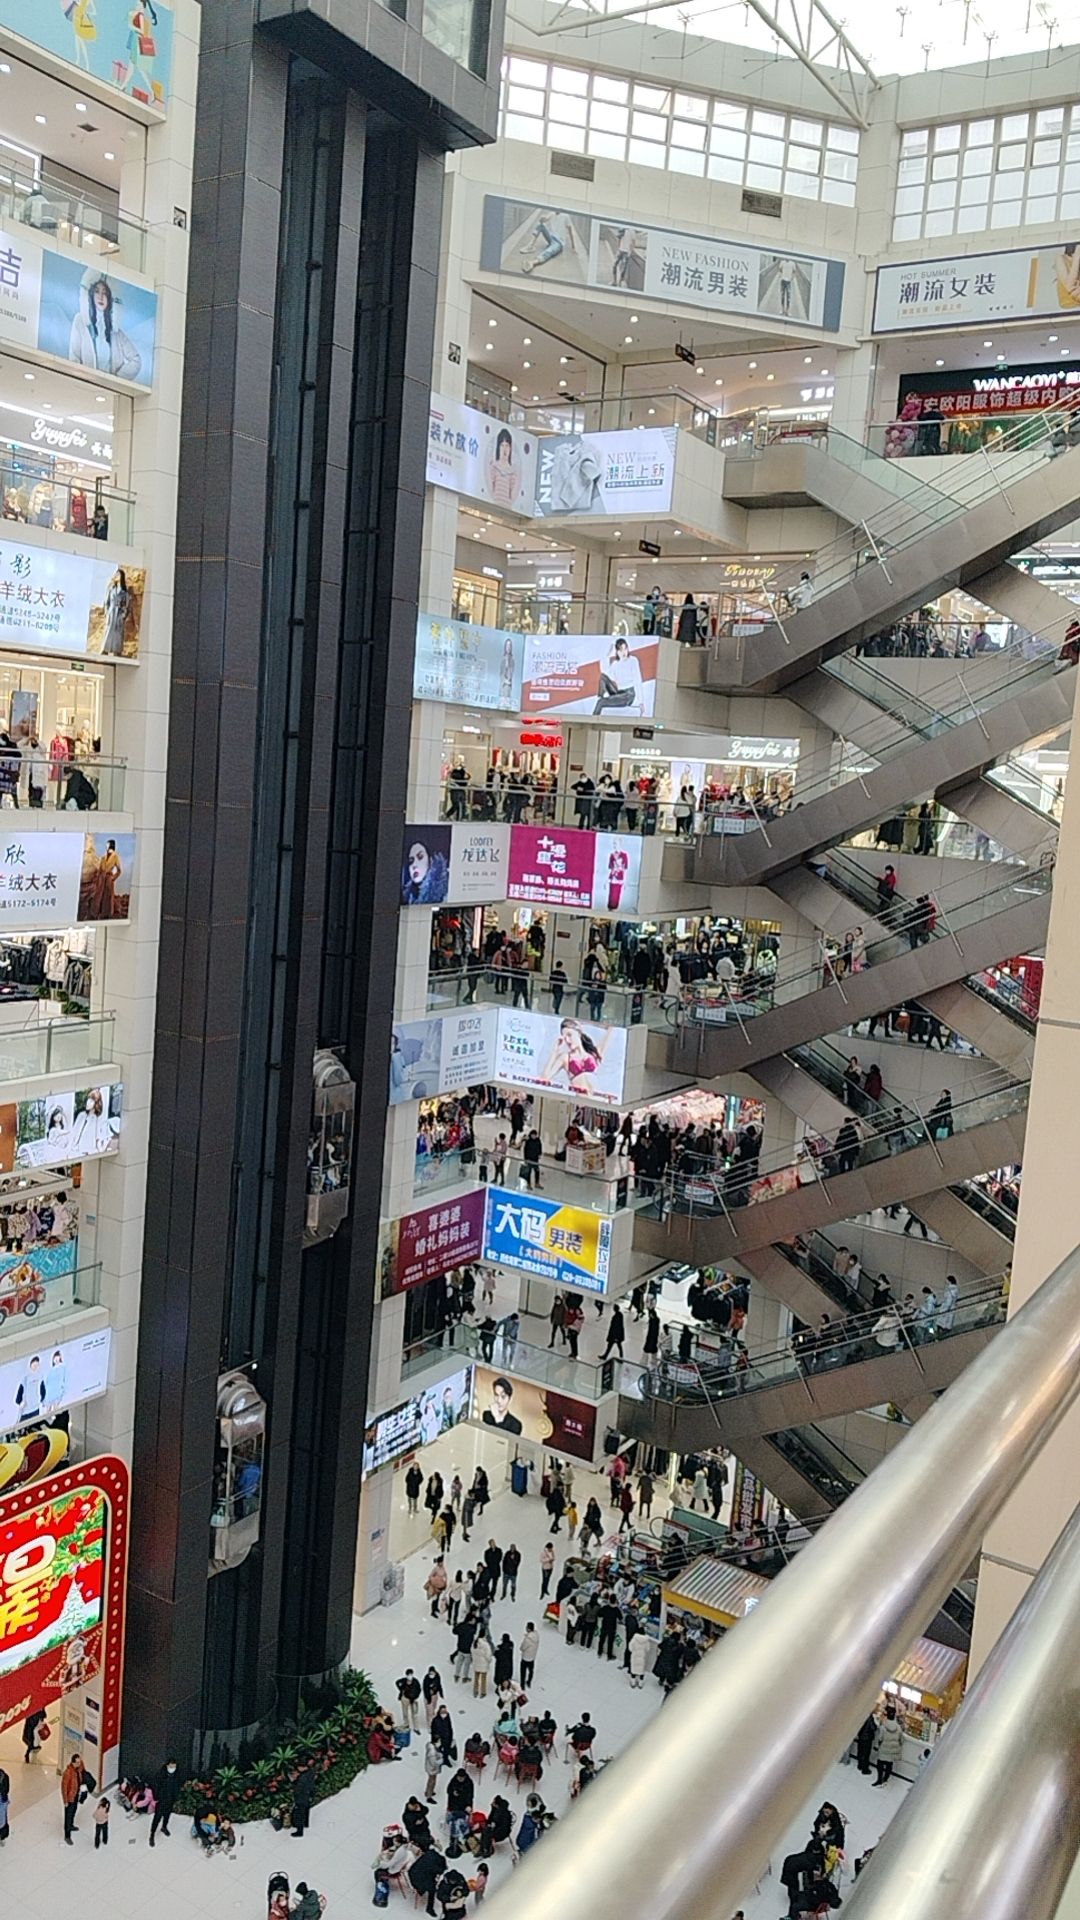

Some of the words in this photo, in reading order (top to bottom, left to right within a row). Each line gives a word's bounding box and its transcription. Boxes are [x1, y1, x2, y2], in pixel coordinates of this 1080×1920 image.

[663, 246, 692, 262] NEW
[695, 252, 749, 272] FASHION
[900, 272, 918, 281] HOT
[920, 267, 957, 279] SUMMER
[660, 261, 749, 298] 潮流男装
[899, 272, 997, 305] 潮流女装
[539, 448, 556, 504] NEW
[495, 1203, 547, 1244] 大码
[548, 1227, 583, 1255] 男装
